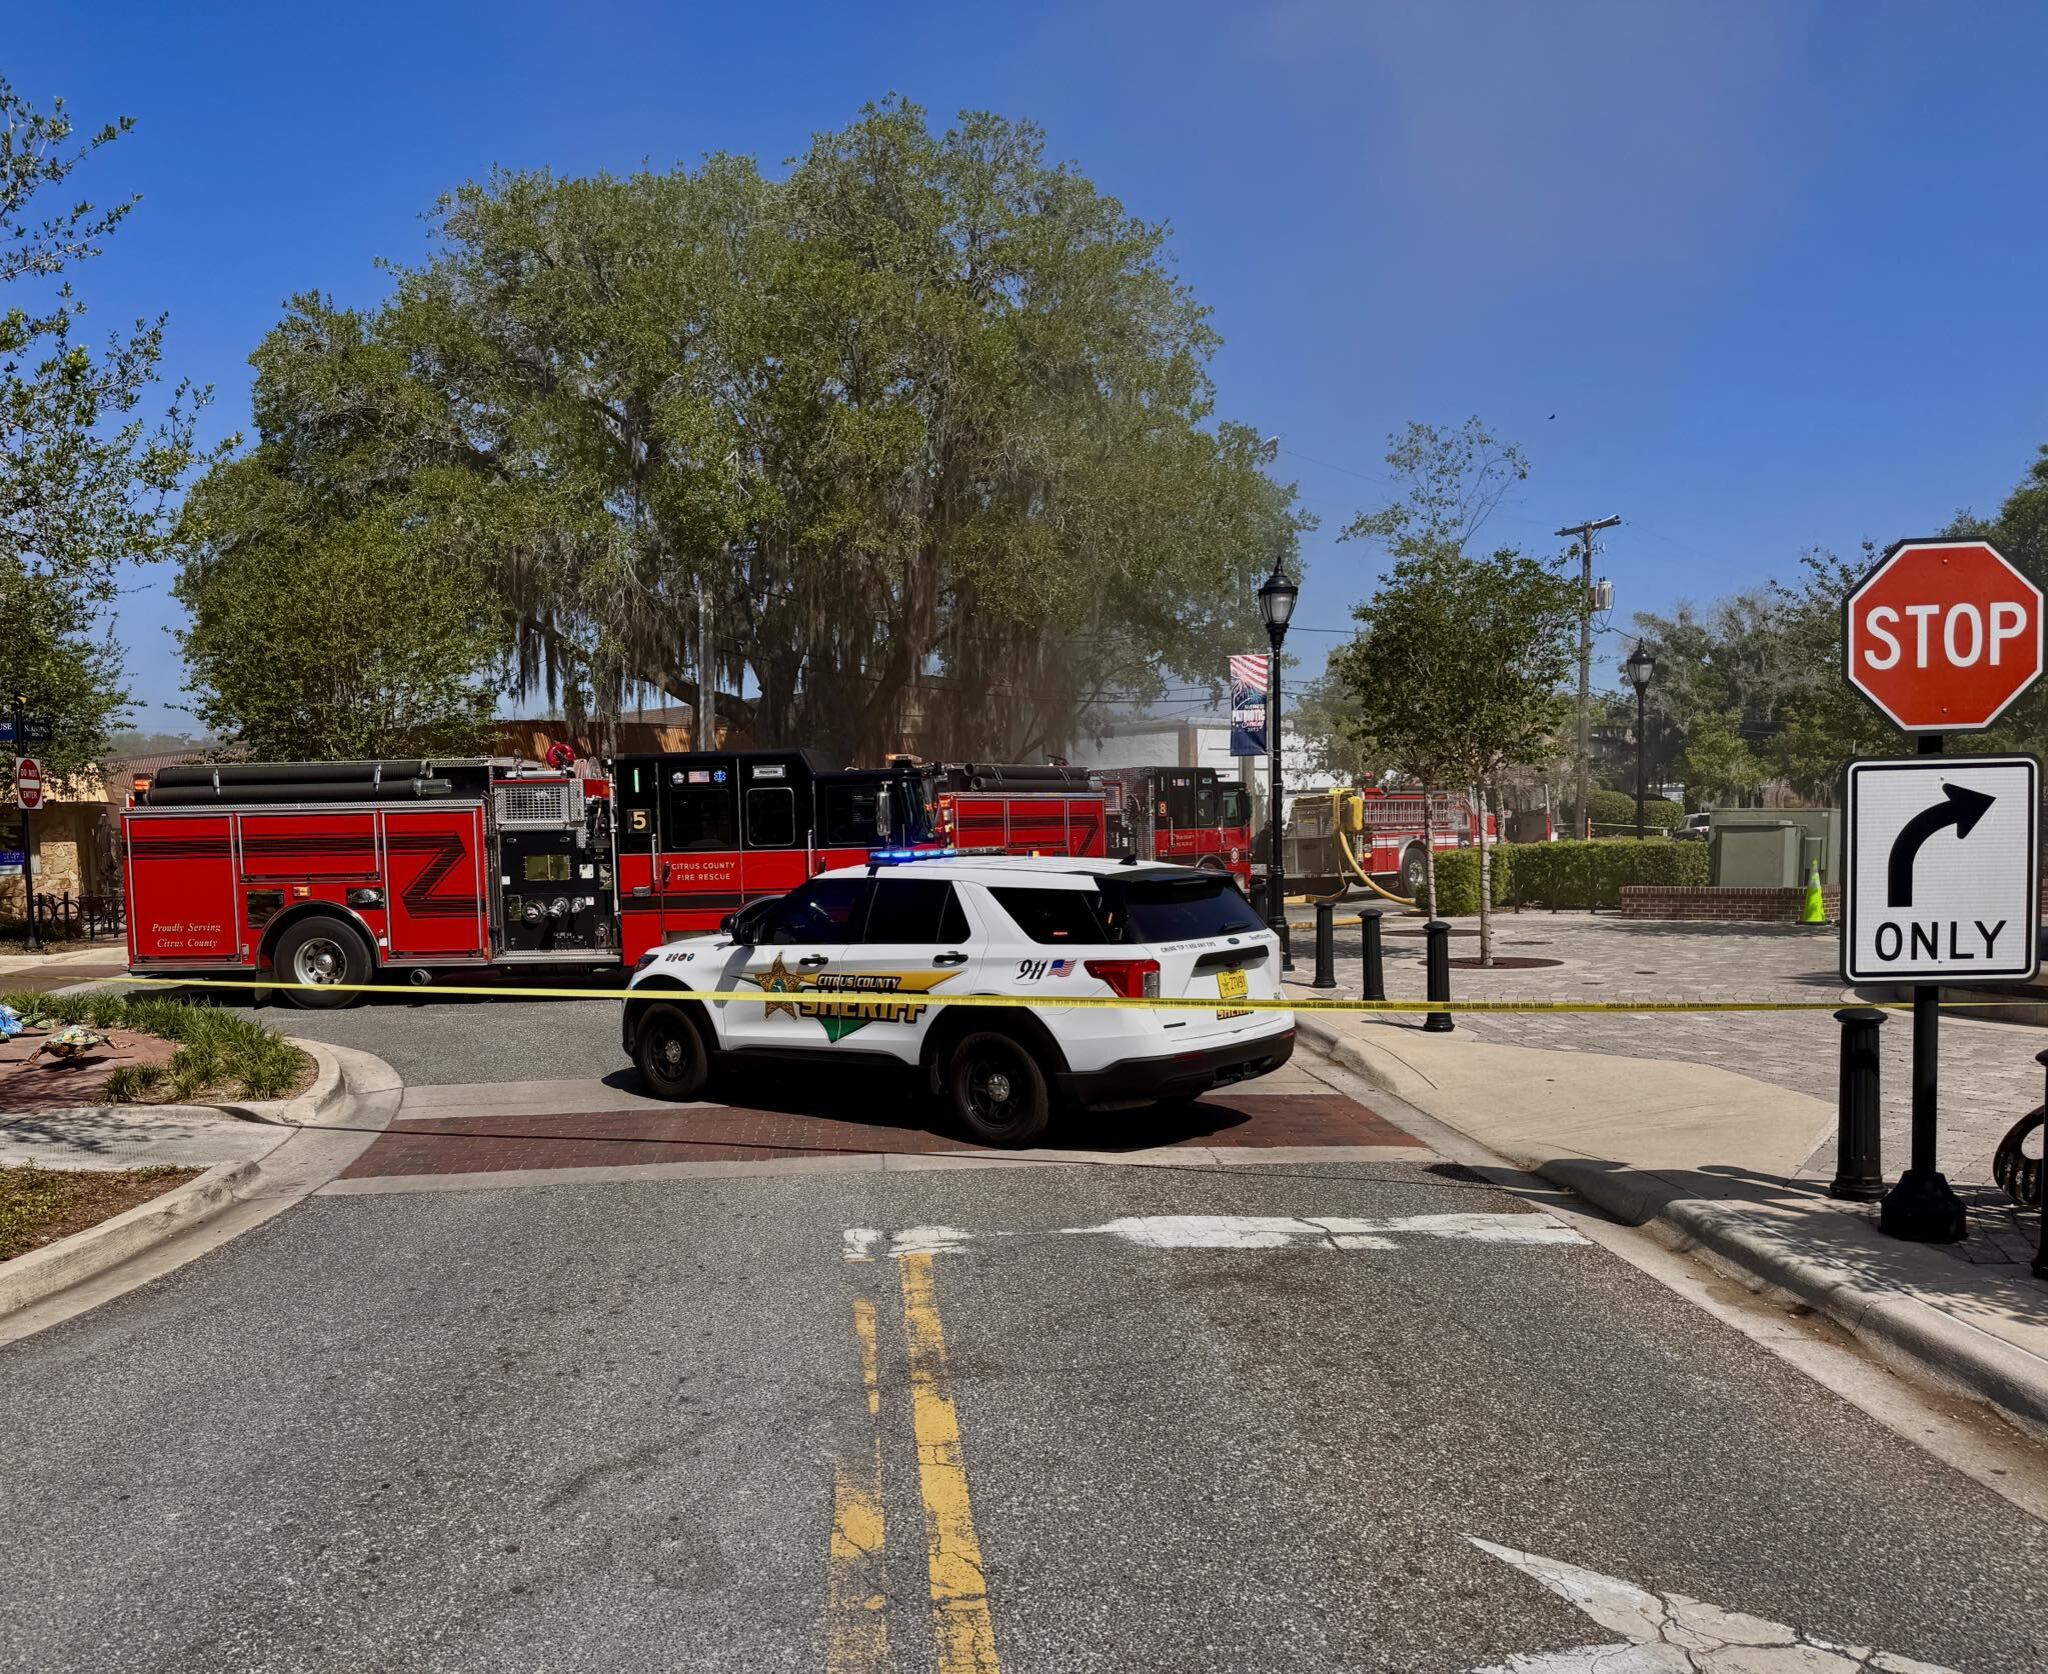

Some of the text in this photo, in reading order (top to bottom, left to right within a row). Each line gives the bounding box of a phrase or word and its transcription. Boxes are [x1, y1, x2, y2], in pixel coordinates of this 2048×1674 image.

[1864, 602, 2027, 670] STOP
[28, 769, 38, 777] NOT
[23, 790, 38, 799] ENTER
[1159, 803, 1167, 814] 8
[632, 811, 647, 830] 5
[698, 873, 731, 881] RESCUE
[152, 923, 221, 933] Proudly Serving
[157, 938, 218, 949] Citrus County
[1875, 920, 2007, 961] ONLY
[818, 975, 900, 988] CITRUS COUNTY
